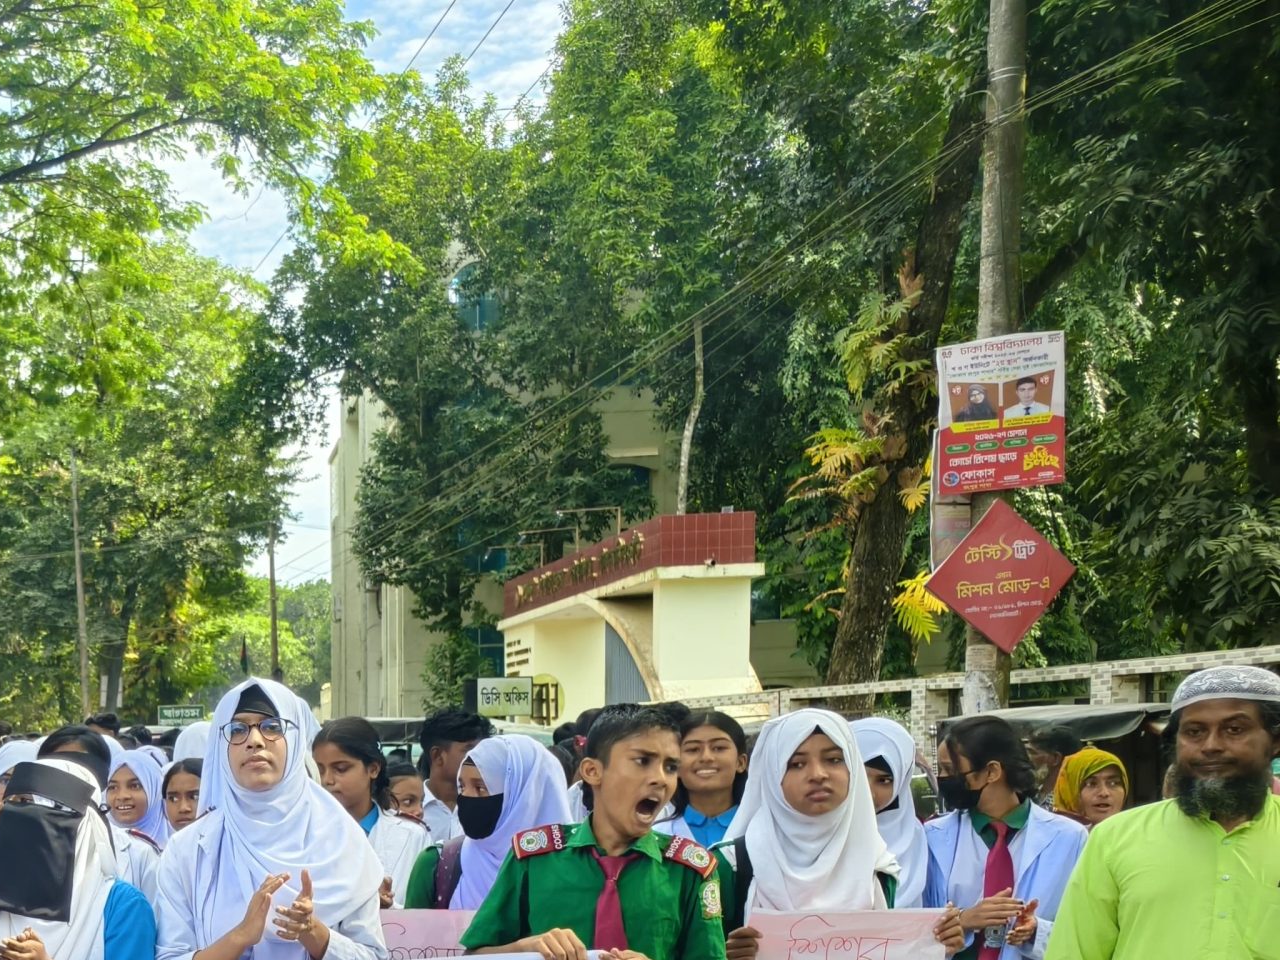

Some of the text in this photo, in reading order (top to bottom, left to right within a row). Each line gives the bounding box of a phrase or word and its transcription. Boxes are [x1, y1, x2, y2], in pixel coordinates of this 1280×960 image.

[959, 343, 983, 356] ঢাকা
[984, 335, 1043, 354] বিশ্ববিদ্যালয়
[959, 468, 996, 481] ফোকাস
[964, 542, 1003, 564] টেস্টি
[956, 580, 994, 600] মিশন
[481, 686, 530, 706] ডিসি অফিস
[551, 824, 564, 850] COGHS
